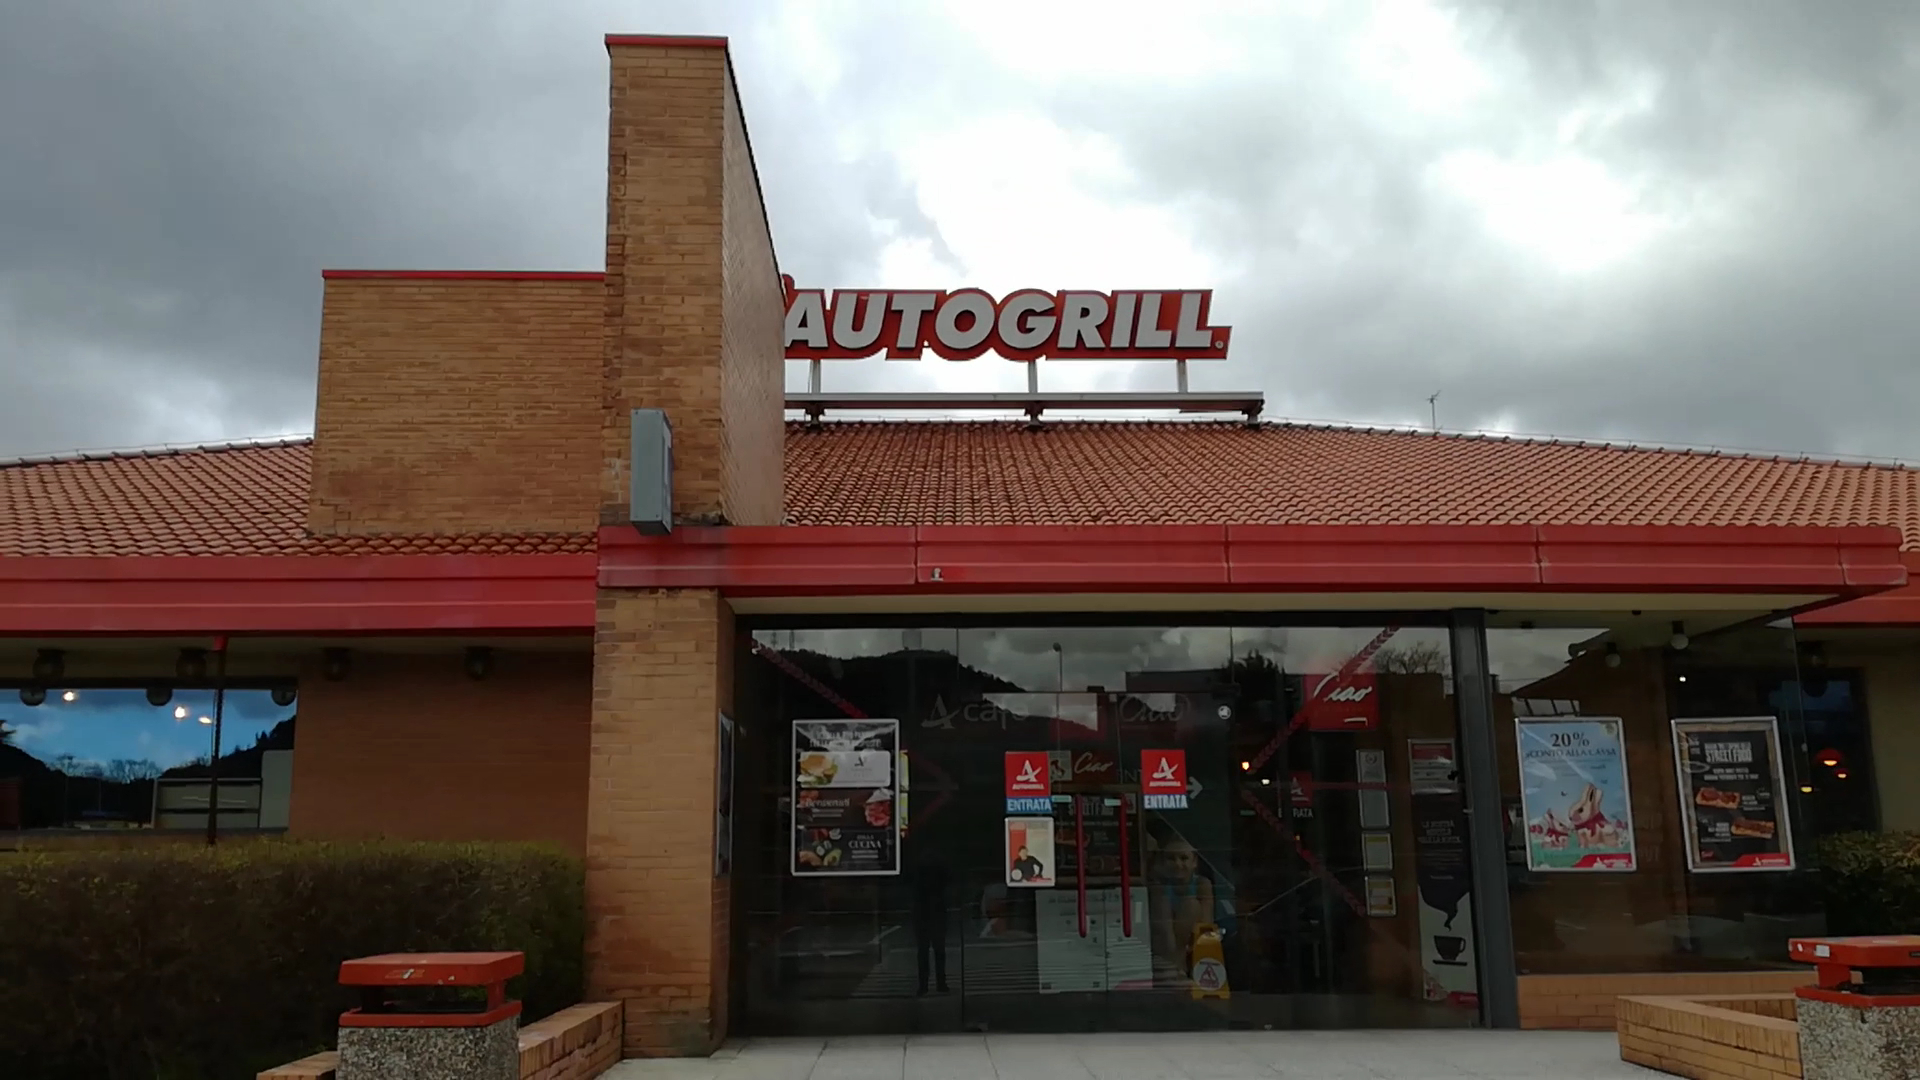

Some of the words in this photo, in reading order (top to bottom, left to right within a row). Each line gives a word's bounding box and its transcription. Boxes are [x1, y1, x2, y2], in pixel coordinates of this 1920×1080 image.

[785, 292, 1213, 349] AUTOGRILL
[1313, 672, 1372, 702] Ciao
[1550, 731, 1590, 747] 20%
[1074, 751, 1113, 774] Ciao
[1007, 798, 1052, 812] ENTRATA
[1144, 794, 1189, 809] ENTRATA
